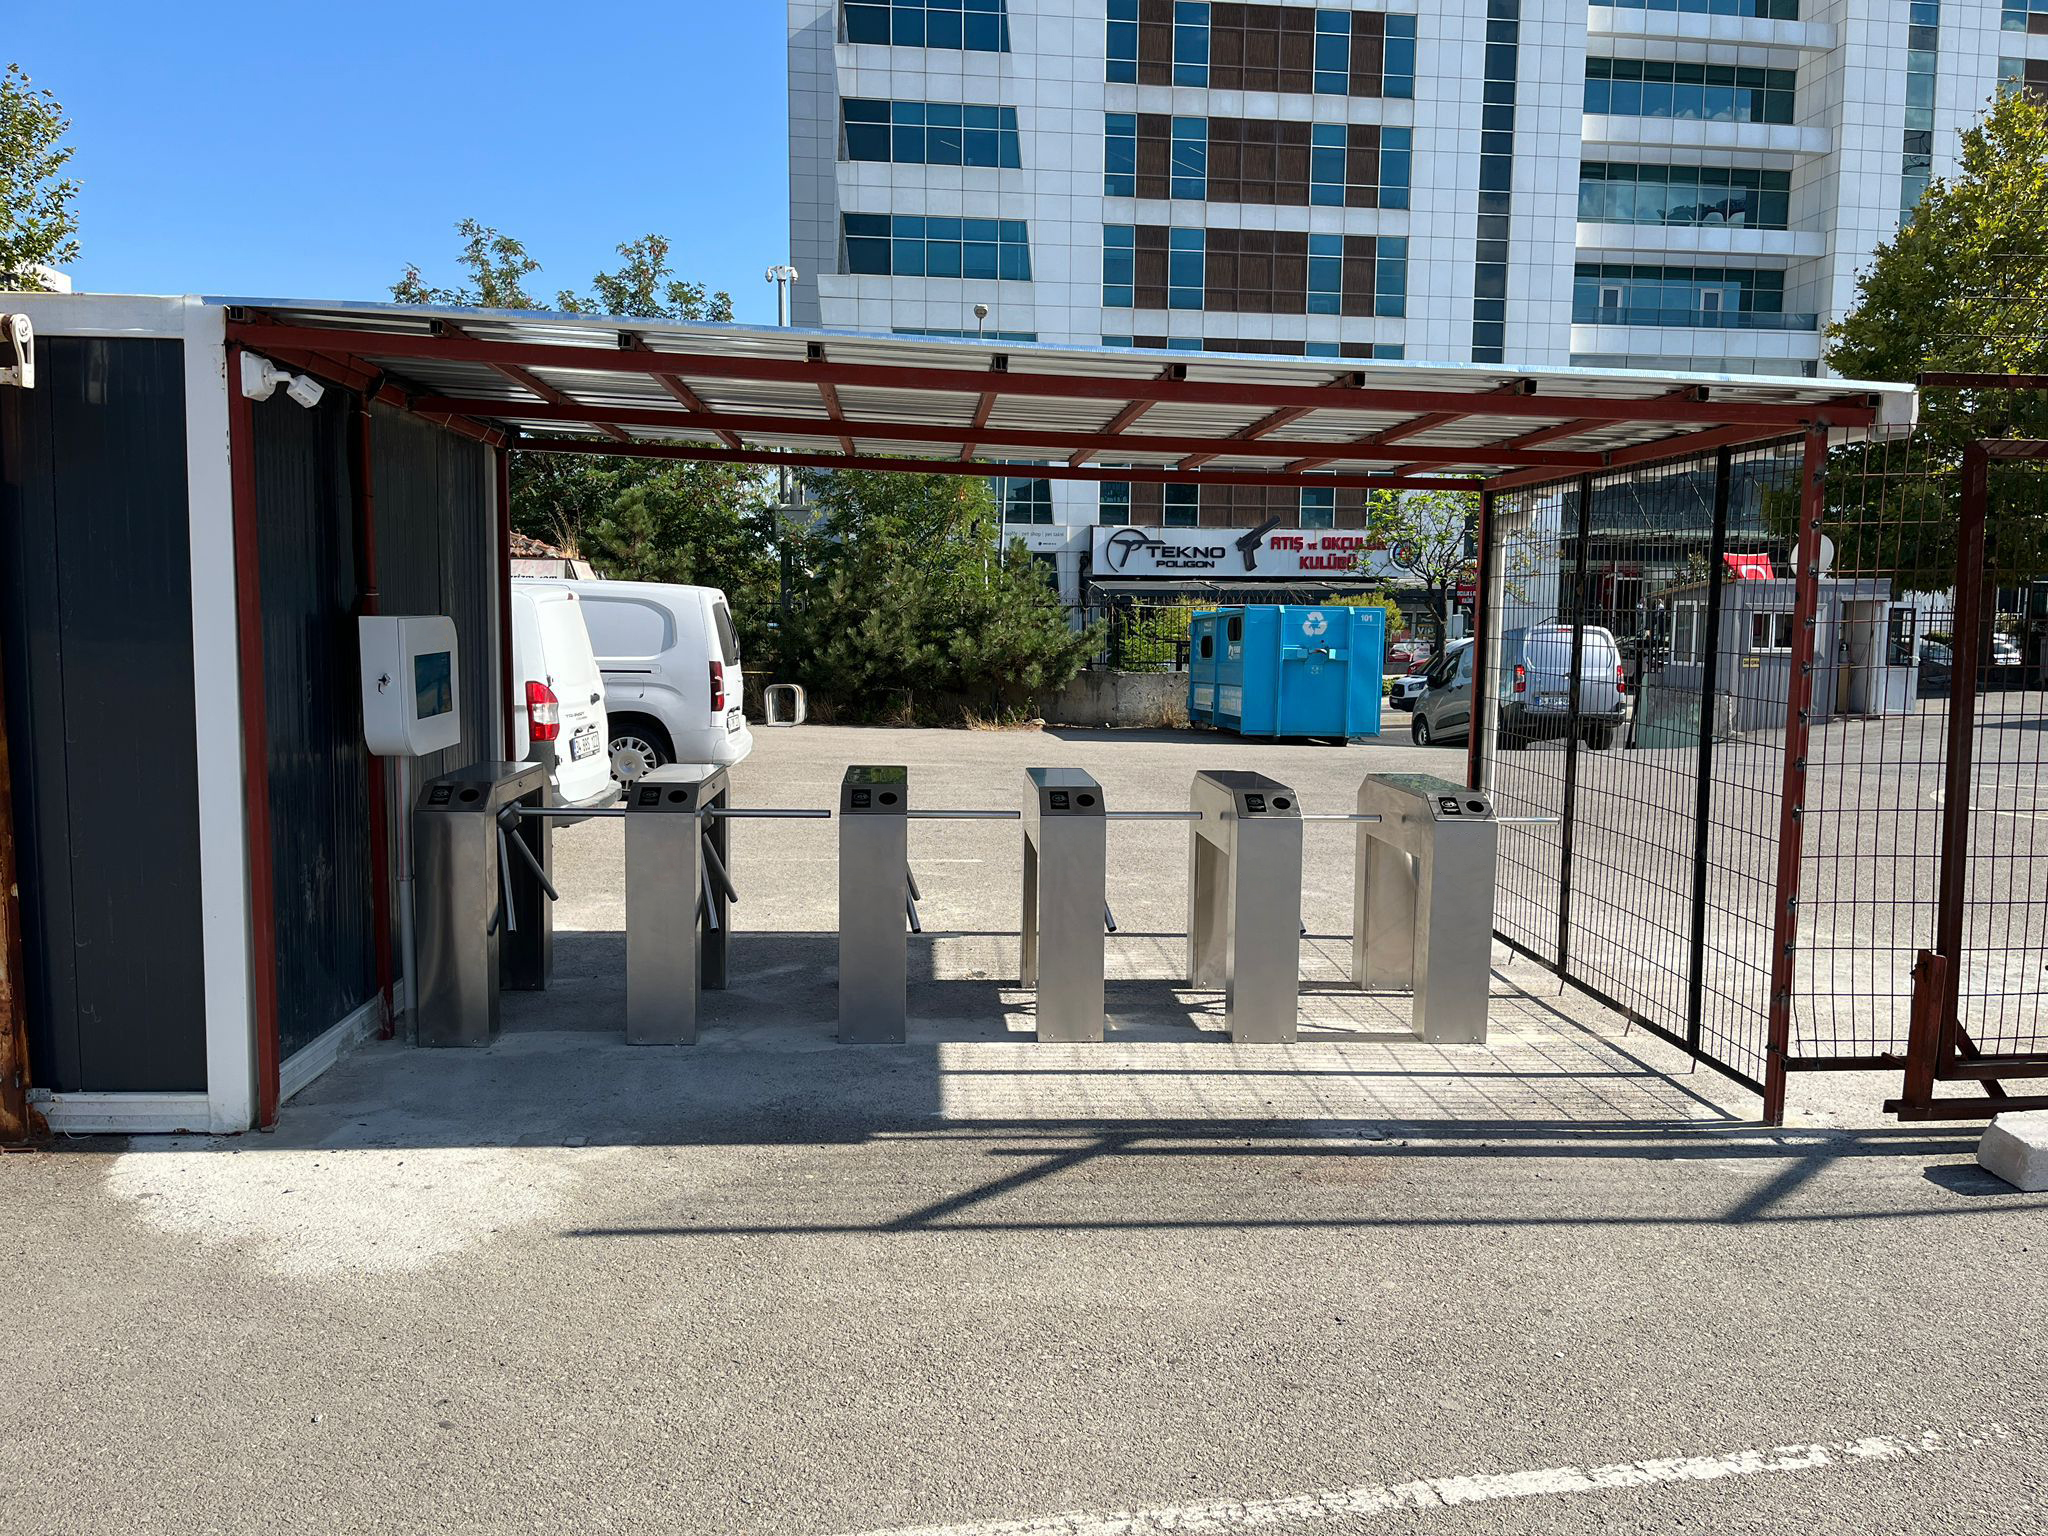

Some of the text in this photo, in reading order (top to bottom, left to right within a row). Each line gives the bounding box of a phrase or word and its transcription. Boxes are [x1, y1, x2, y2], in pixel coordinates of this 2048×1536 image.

[1270, 536, 1304, 553] ATIŞ
[1146, 546, 1226, 558] TEKNO
[1156, 560, 1215, 568] POLIGON
[1360, 614, 1373, 622] 101
